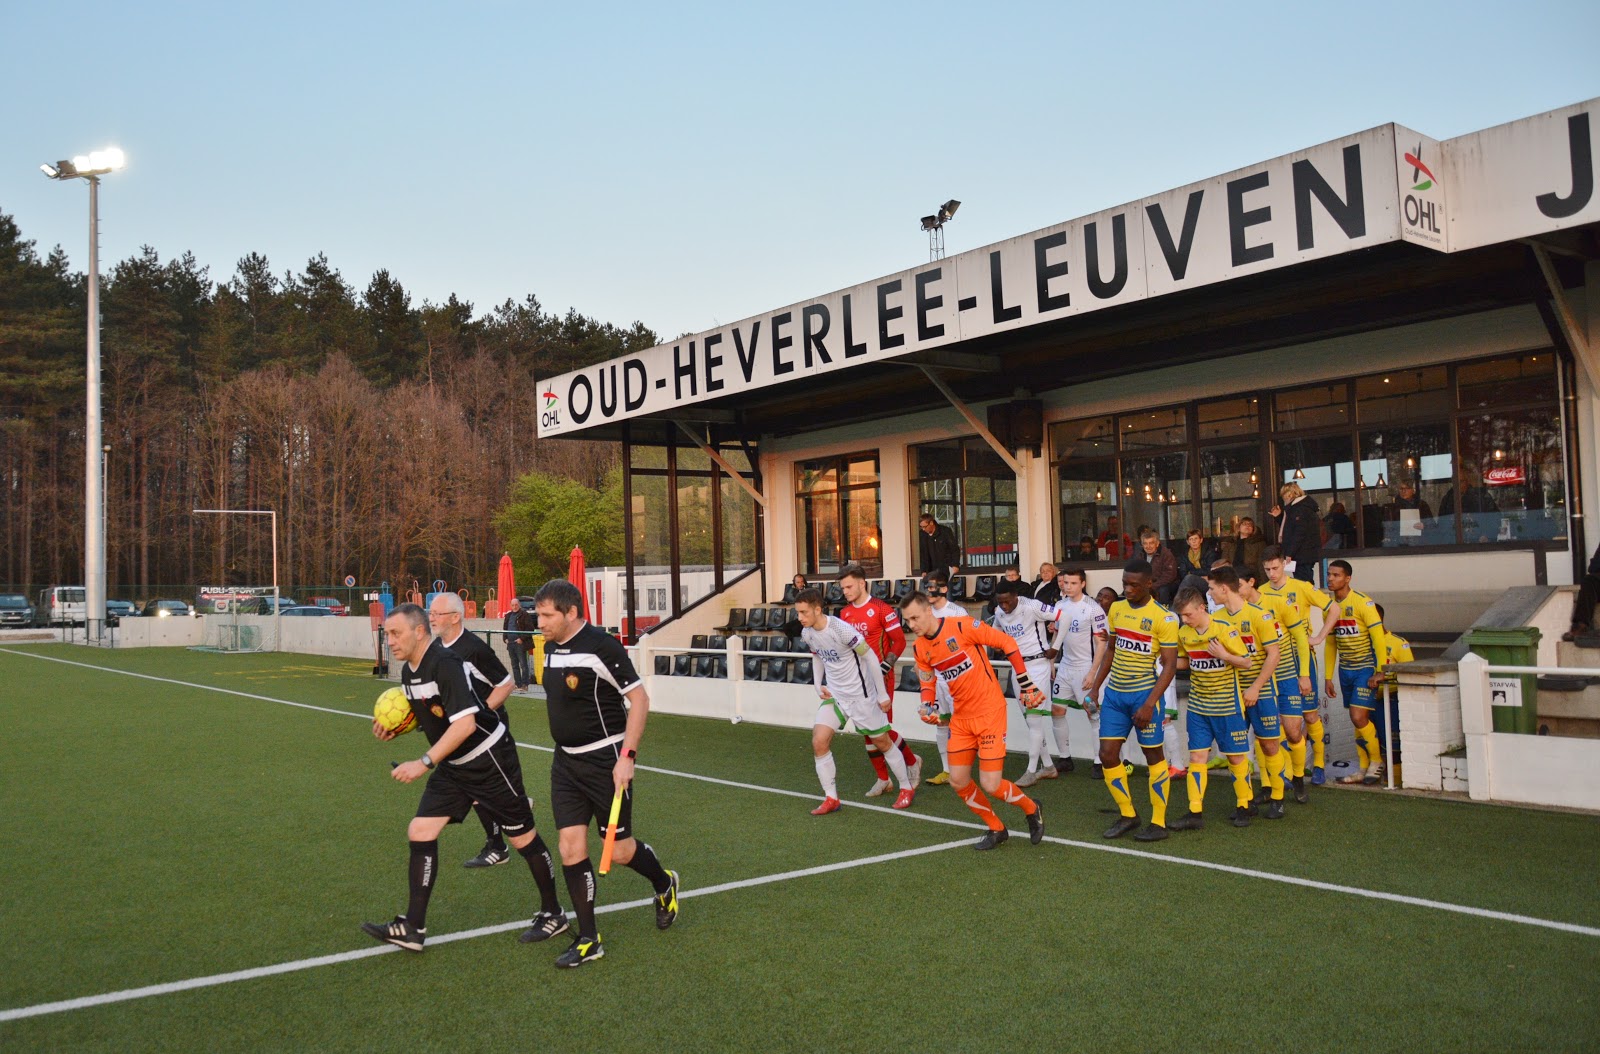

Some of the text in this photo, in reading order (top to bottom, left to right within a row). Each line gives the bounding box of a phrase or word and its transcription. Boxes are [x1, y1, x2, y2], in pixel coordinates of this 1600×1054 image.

[1404, 194, 1441, 234] OHL
[568, 143, 1366, 424] OUD-HEVERLEE-LEUVEN
[542, 409, 560, 428] OHL
[1488, 467, 1517, 480] Coca-Cola
[1005, 623, 1024, 634] KING
[816, 649, 838, 657] KING
[1053, 683, 1060, 695] 3
